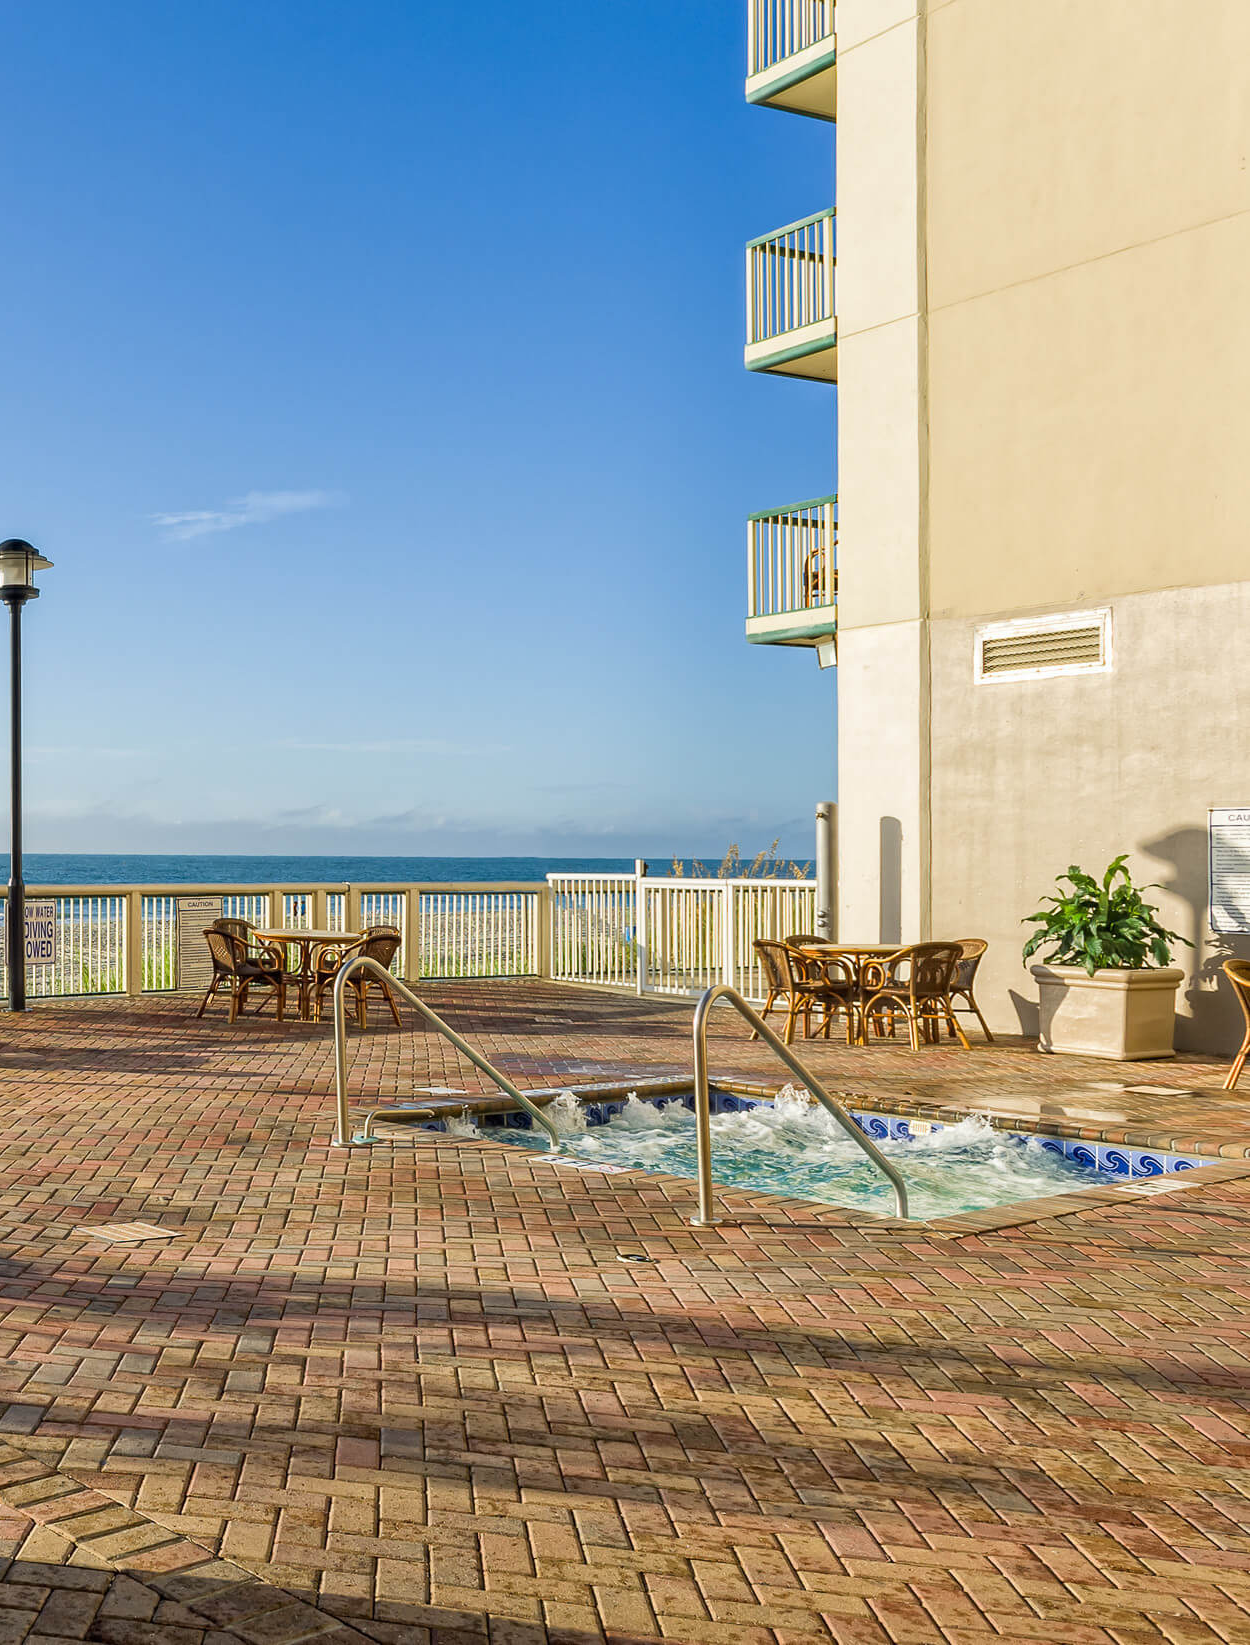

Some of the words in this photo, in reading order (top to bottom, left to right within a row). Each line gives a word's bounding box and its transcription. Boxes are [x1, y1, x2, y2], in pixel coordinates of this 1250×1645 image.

[36, 906, 53, 918] WATER
[25, 921, 53, 939] DIVING
[26, 940, 52, 959] OWED
